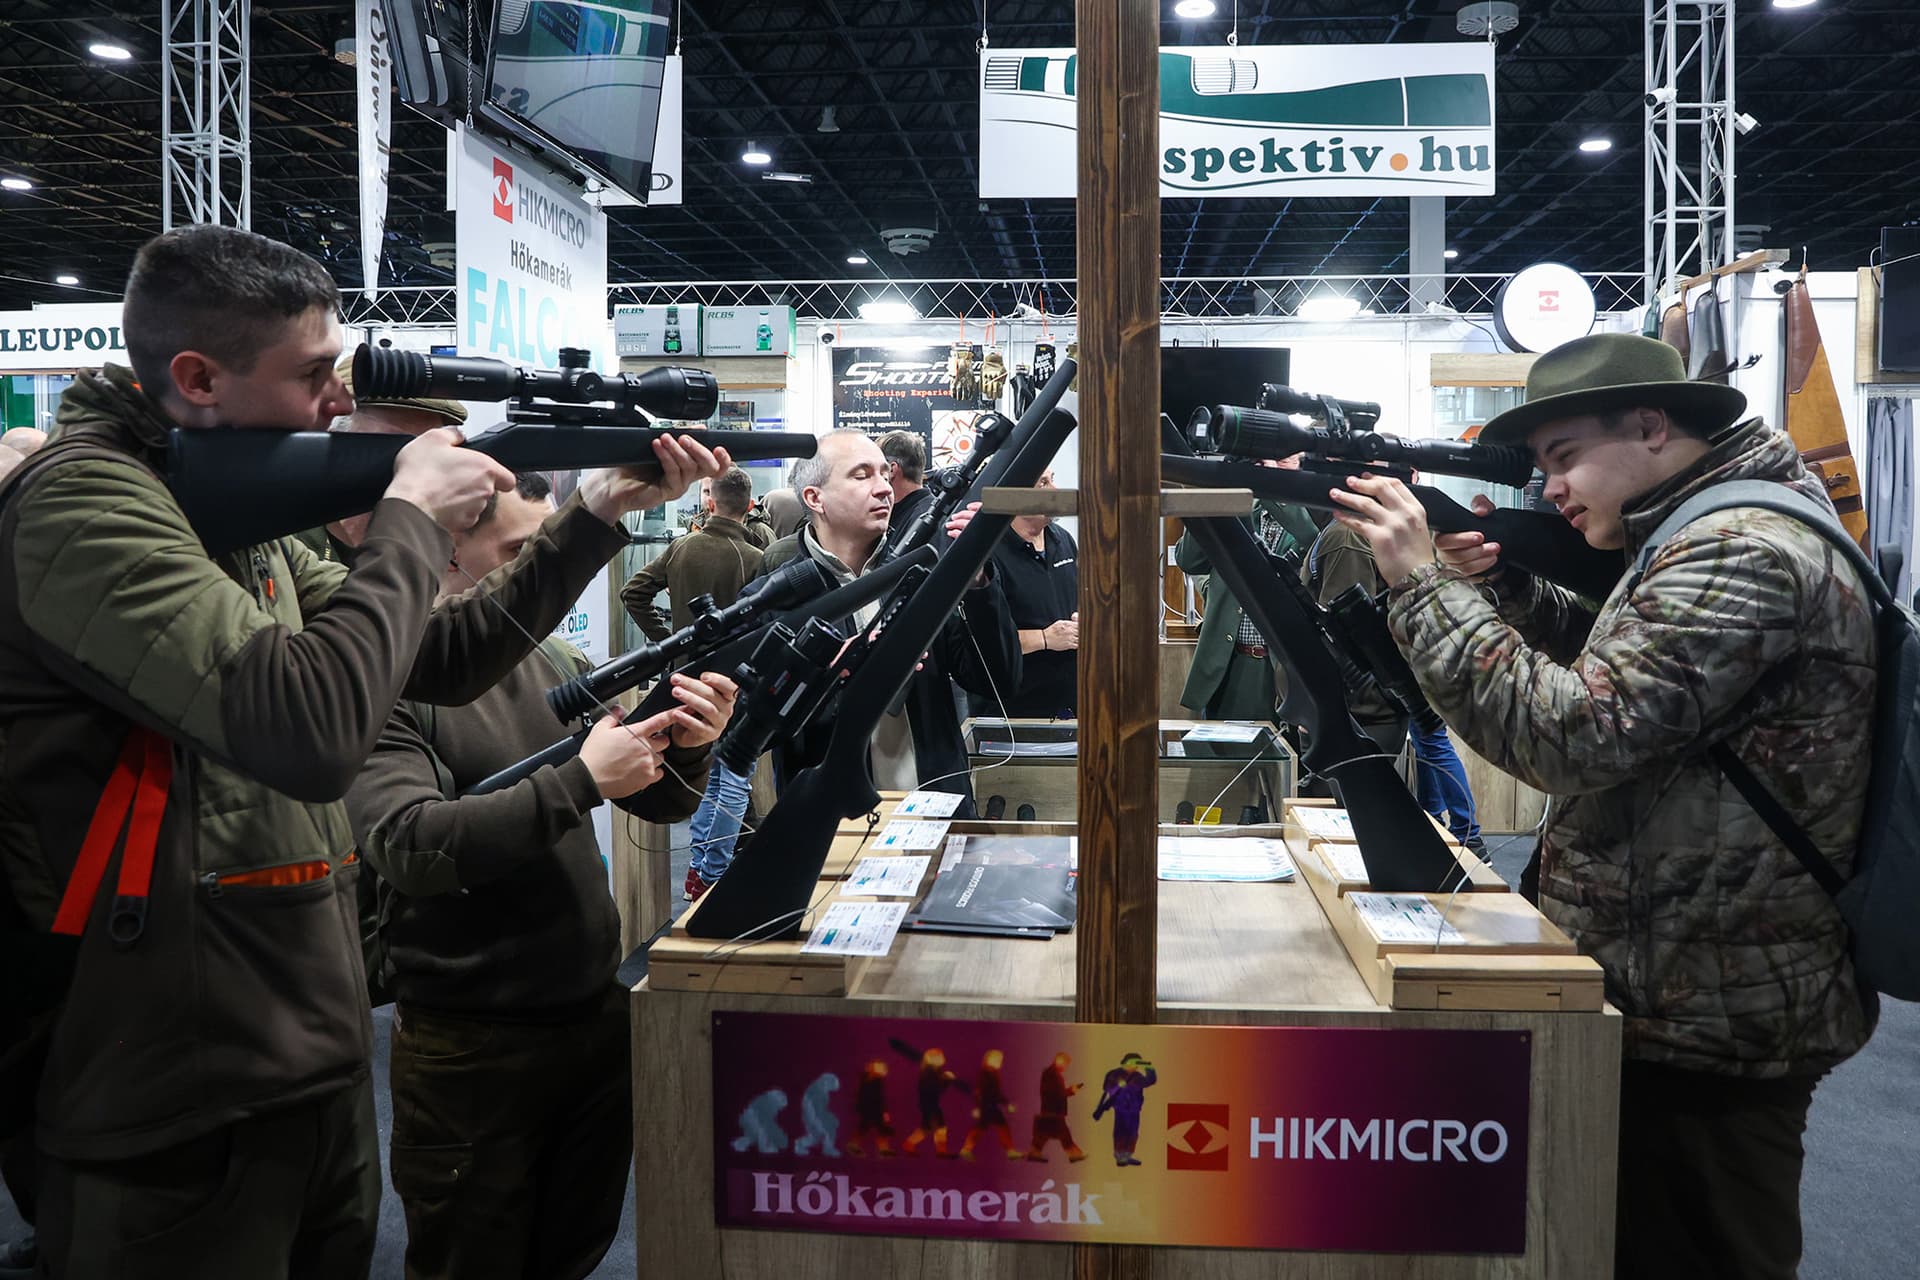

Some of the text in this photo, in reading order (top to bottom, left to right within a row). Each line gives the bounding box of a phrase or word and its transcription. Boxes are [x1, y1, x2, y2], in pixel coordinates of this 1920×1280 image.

[1163, 136, 1491, 182] spektiv.hu
[518, 184, 586, 250] HIKMICRO
[510, 239, 573, 292] Hőkamerák
[467, 266, 604, 376] FALC
[618, 307, 645, 315] RCBS
[707, 311, 735, 319] RCBS
[0, 327, 127, 351] LEUPOL
[568, 613, 588, 634] OLED
[1249, 1116, 1509, 1164] HIKMICRO
[751, 1170, 1105, 1226] Hőkamerák
